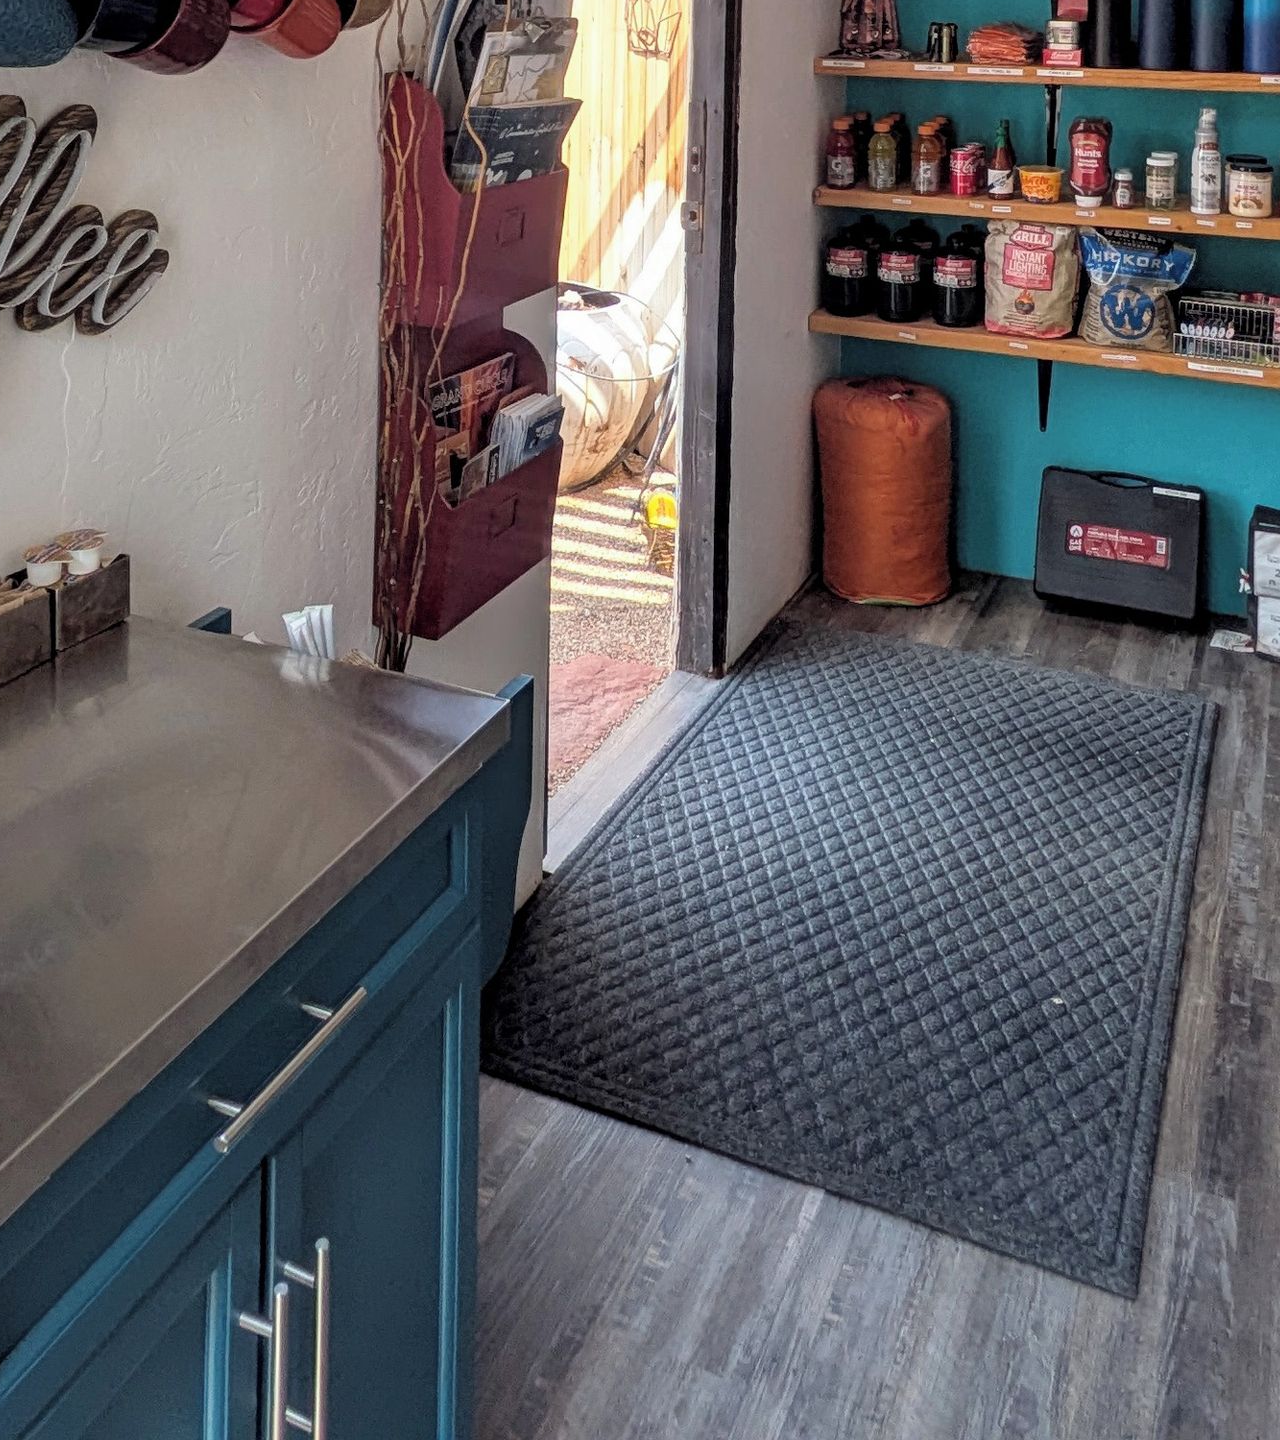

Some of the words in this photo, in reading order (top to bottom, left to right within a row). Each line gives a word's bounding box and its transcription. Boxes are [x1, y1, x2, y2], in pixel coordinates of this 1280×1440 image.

[1011, 230, 1051, 246] GRILL
[1011, 250, 1048, 264] INSTANT
[1090, 249, 1176, 273] HICKORY
[1008, 260, 1047, 275] LIGHTING
